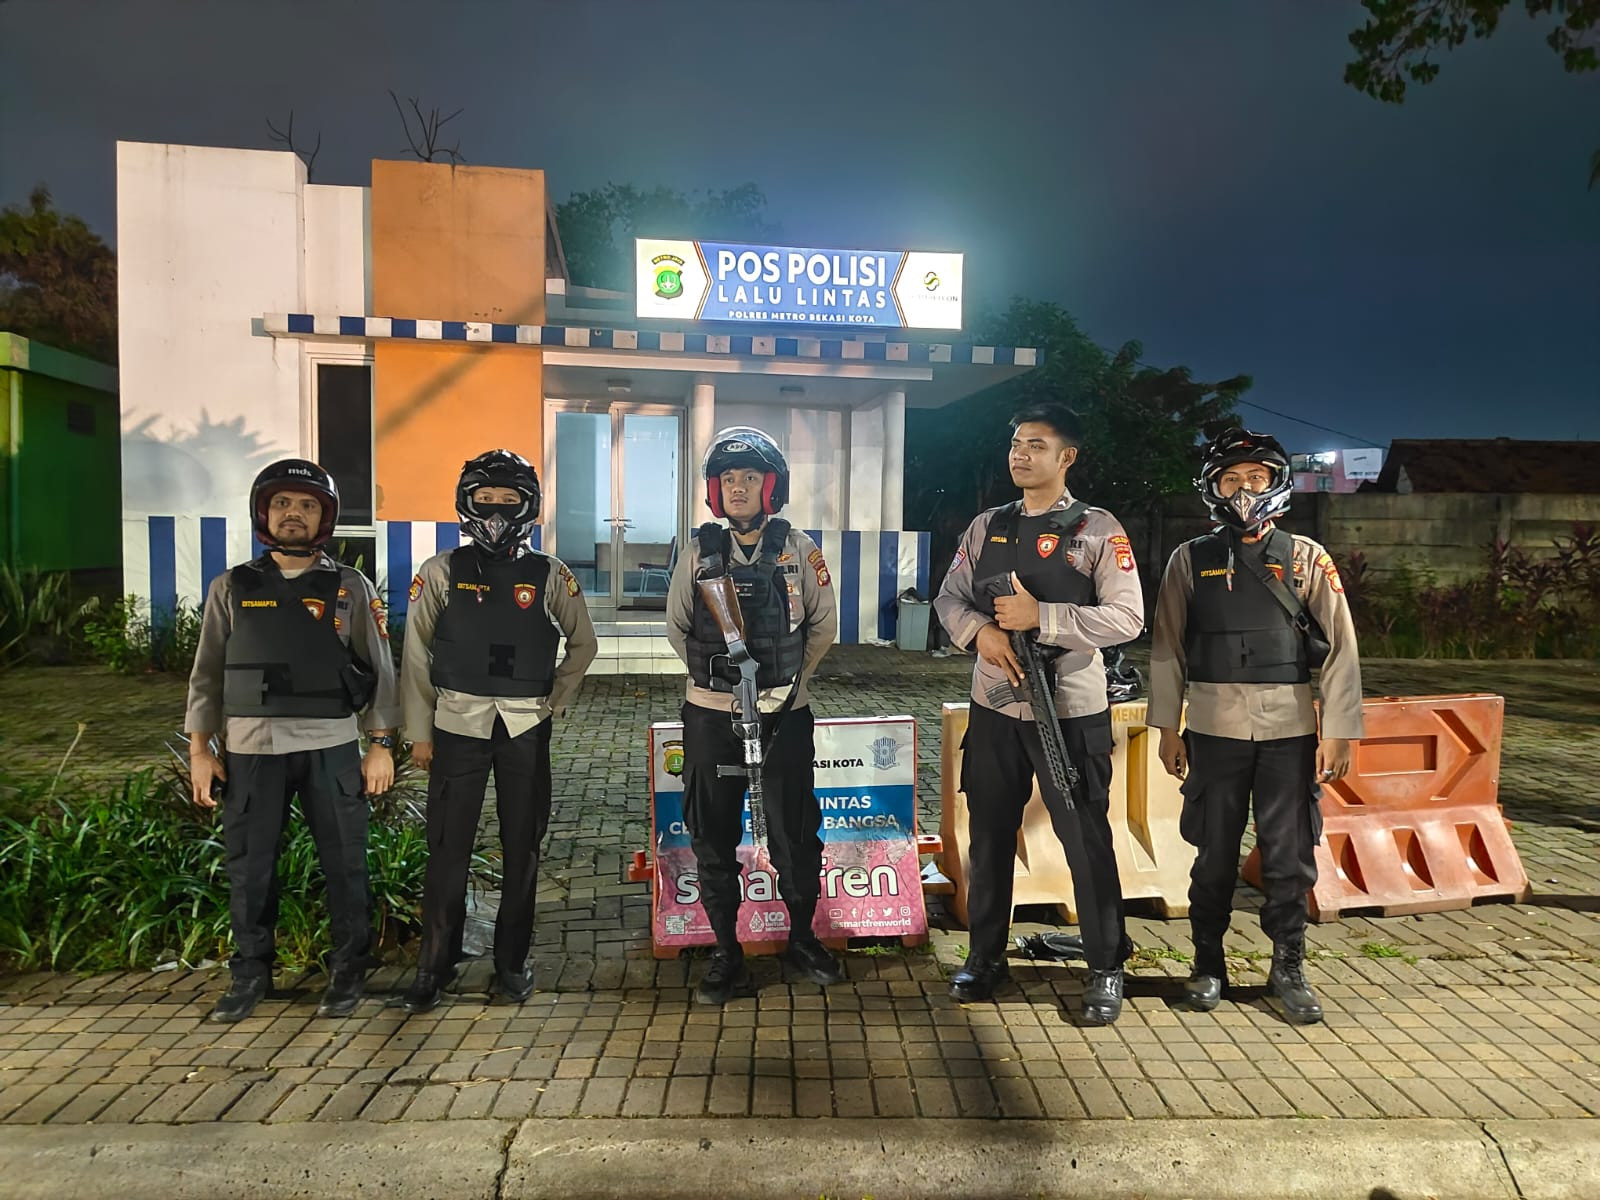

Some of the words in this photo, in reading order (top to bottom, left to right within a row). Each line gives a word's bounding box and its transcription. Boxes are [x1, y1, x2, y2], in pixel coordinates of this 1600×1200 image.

[718, 250, 781, 283] POS
[788, 253, 886, 287] POLISI
[718, 284, 782, 305] LALU
[797, 287, 886, 309] LINTAS
[729, 310, 767, 320] POLRES
[771, 312, 806, 321] METRO
[809, 313, 846, 323] BEKASI
[849, 314, 875, 324] KOTA
[813, 760, 831, 769] ASI
[833, 758, 864, 769] KOTA
[820, 795, 872, 810] INTAS
[823, 814, 900, 831] BANGSA
[831, 917, 912, 930] @smartfrenworld
